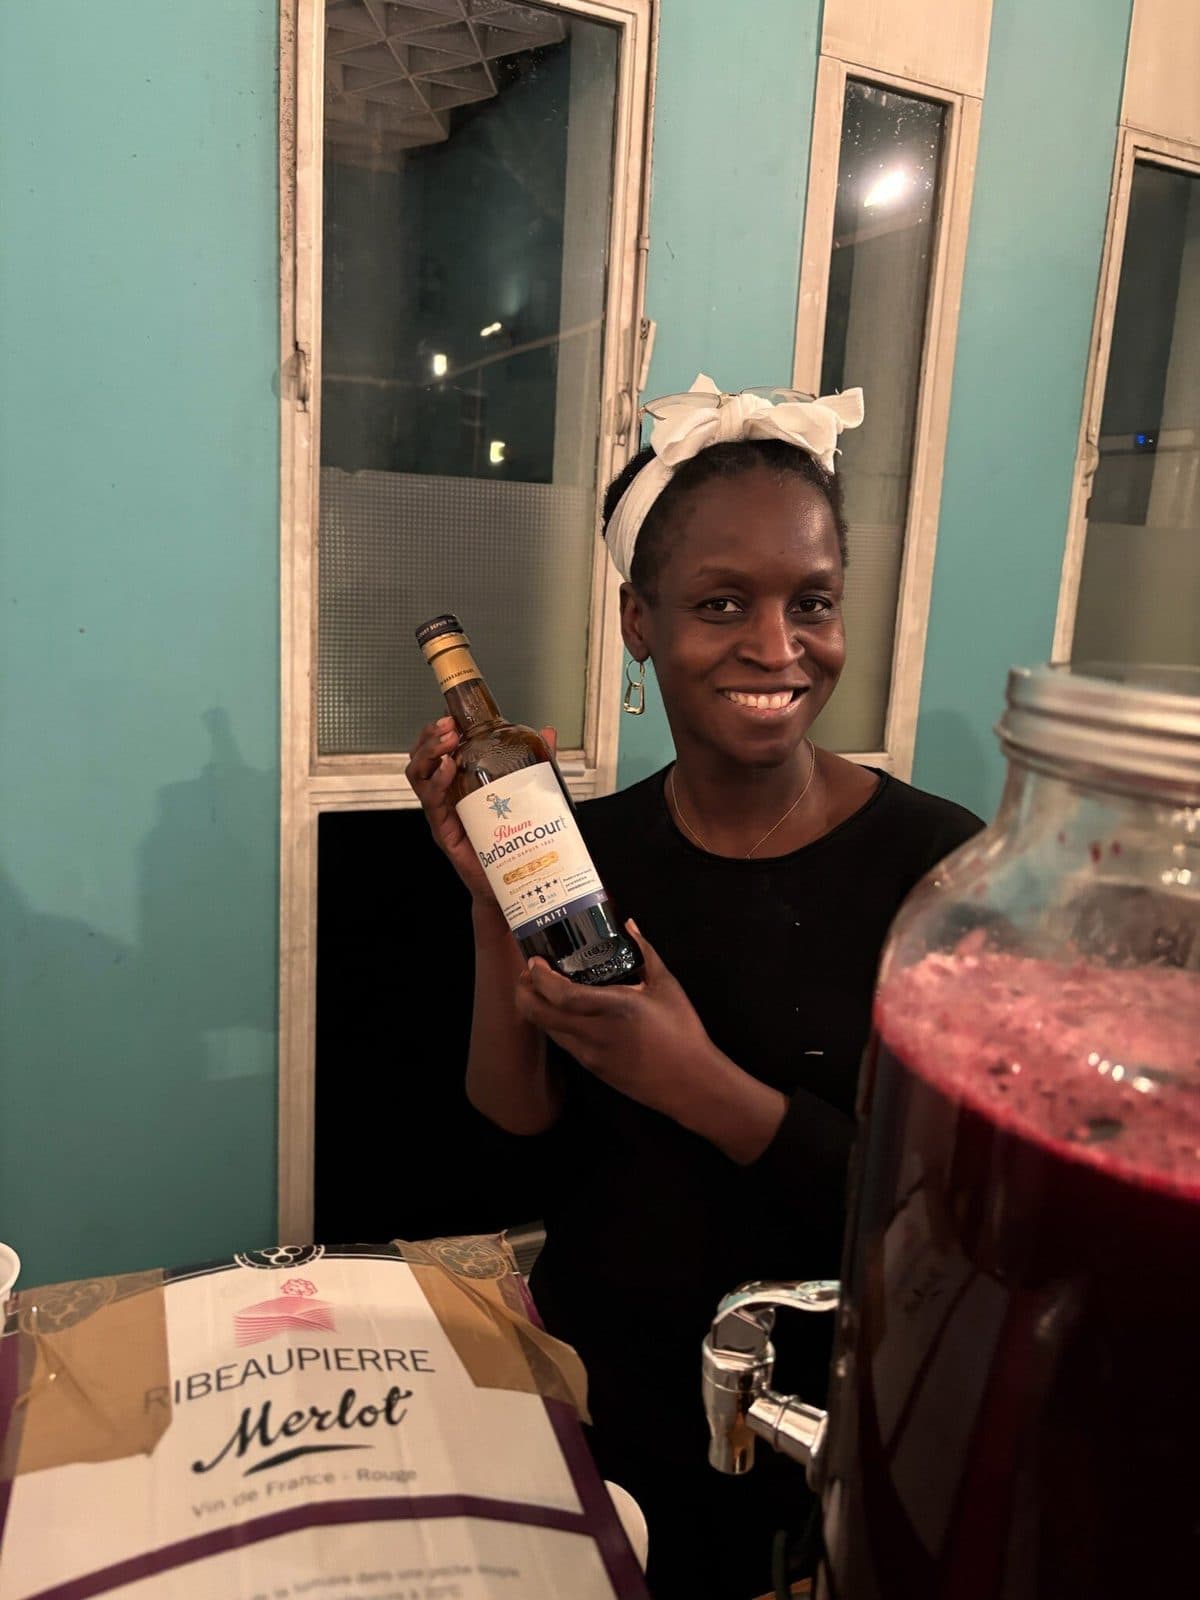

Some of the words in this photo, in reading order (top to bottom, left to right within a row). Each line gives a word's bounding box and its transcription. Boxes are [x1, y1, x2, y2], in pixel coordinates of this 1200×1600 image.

[479, 815, 568, 868] Barbancourt
[493, 819, 533, 843] Rhum
[536, 907, 568, 927] HAITI
[538, 895, 546, 904] 8
[144, 1347, 436, 1414] RIBEAUPIERRE
[191, 1385, 413, 1473] Merlot
[191, 1500, 226, 1517] Vin
[232, 1488, 258, 1505] de
[265, 1470, 335, 1496] France
[356, 1467, 417, 1483] Rouge
